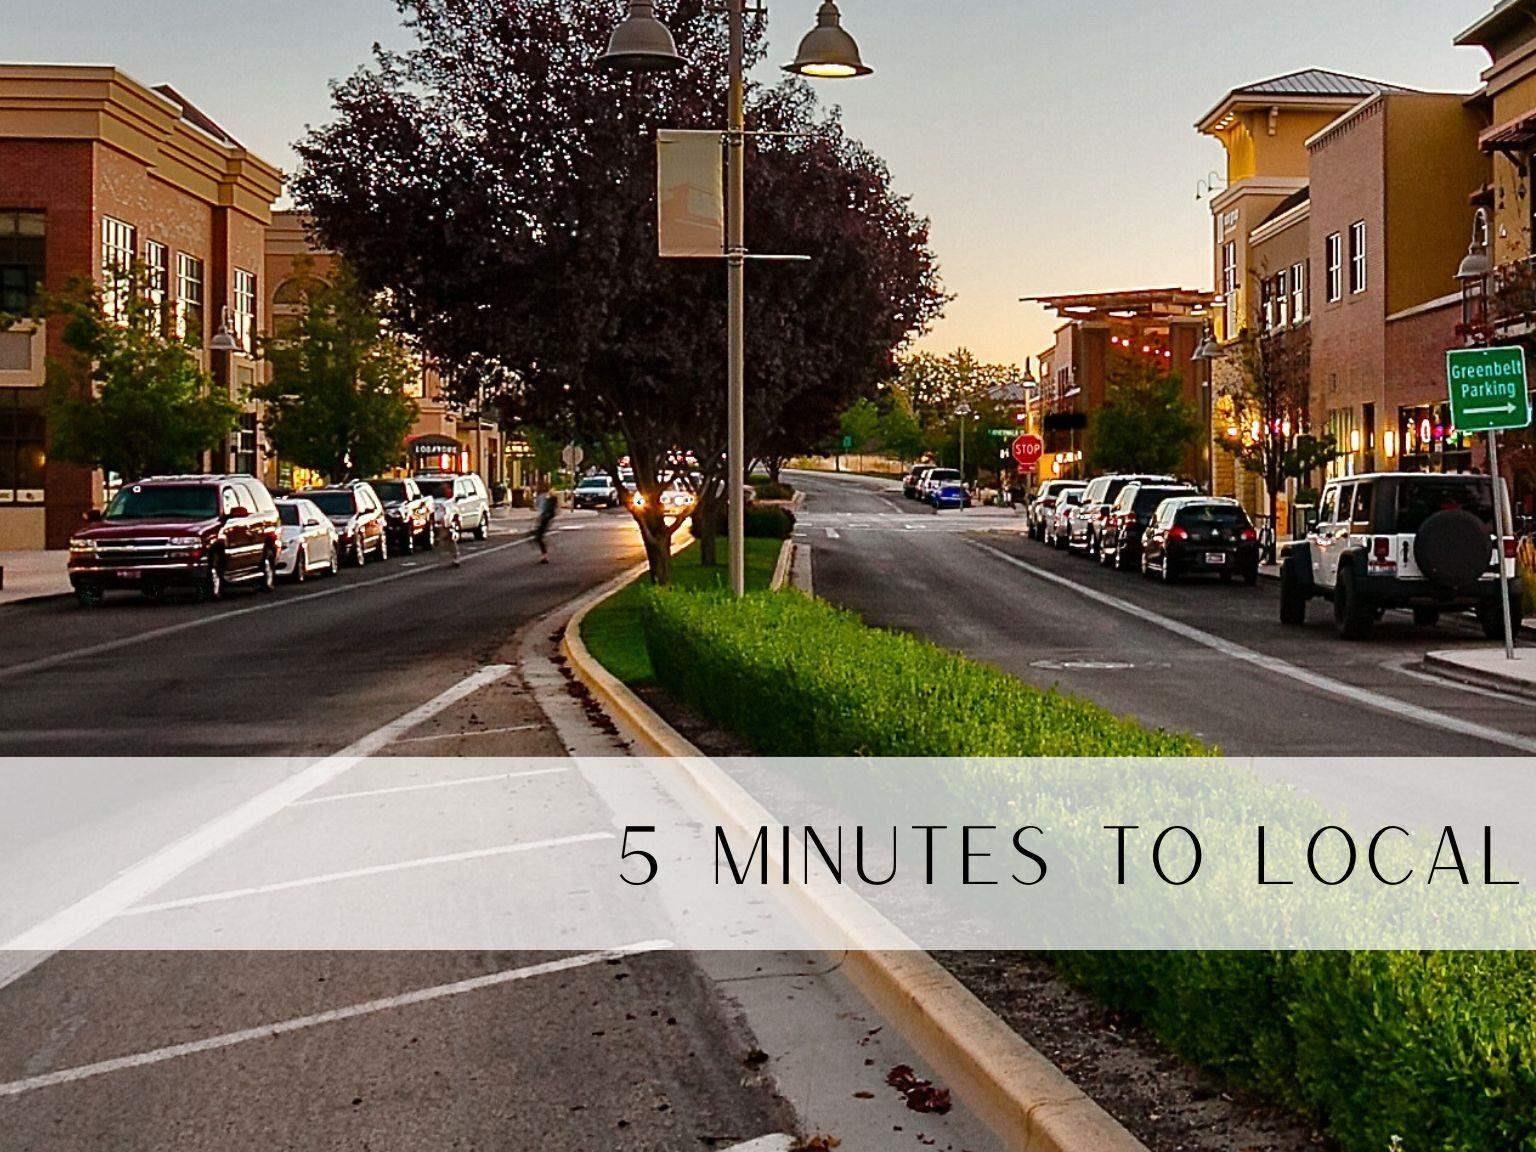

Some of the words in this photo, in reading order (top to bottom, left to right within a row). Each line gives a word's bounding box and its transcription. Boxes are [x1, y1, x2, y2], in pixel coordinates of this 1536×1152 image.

[1451, 359, 1522, 379] Greenbelt
[1461, 380, 1516, 398] Parking
[1015, 444, 1041, 455] STOP
